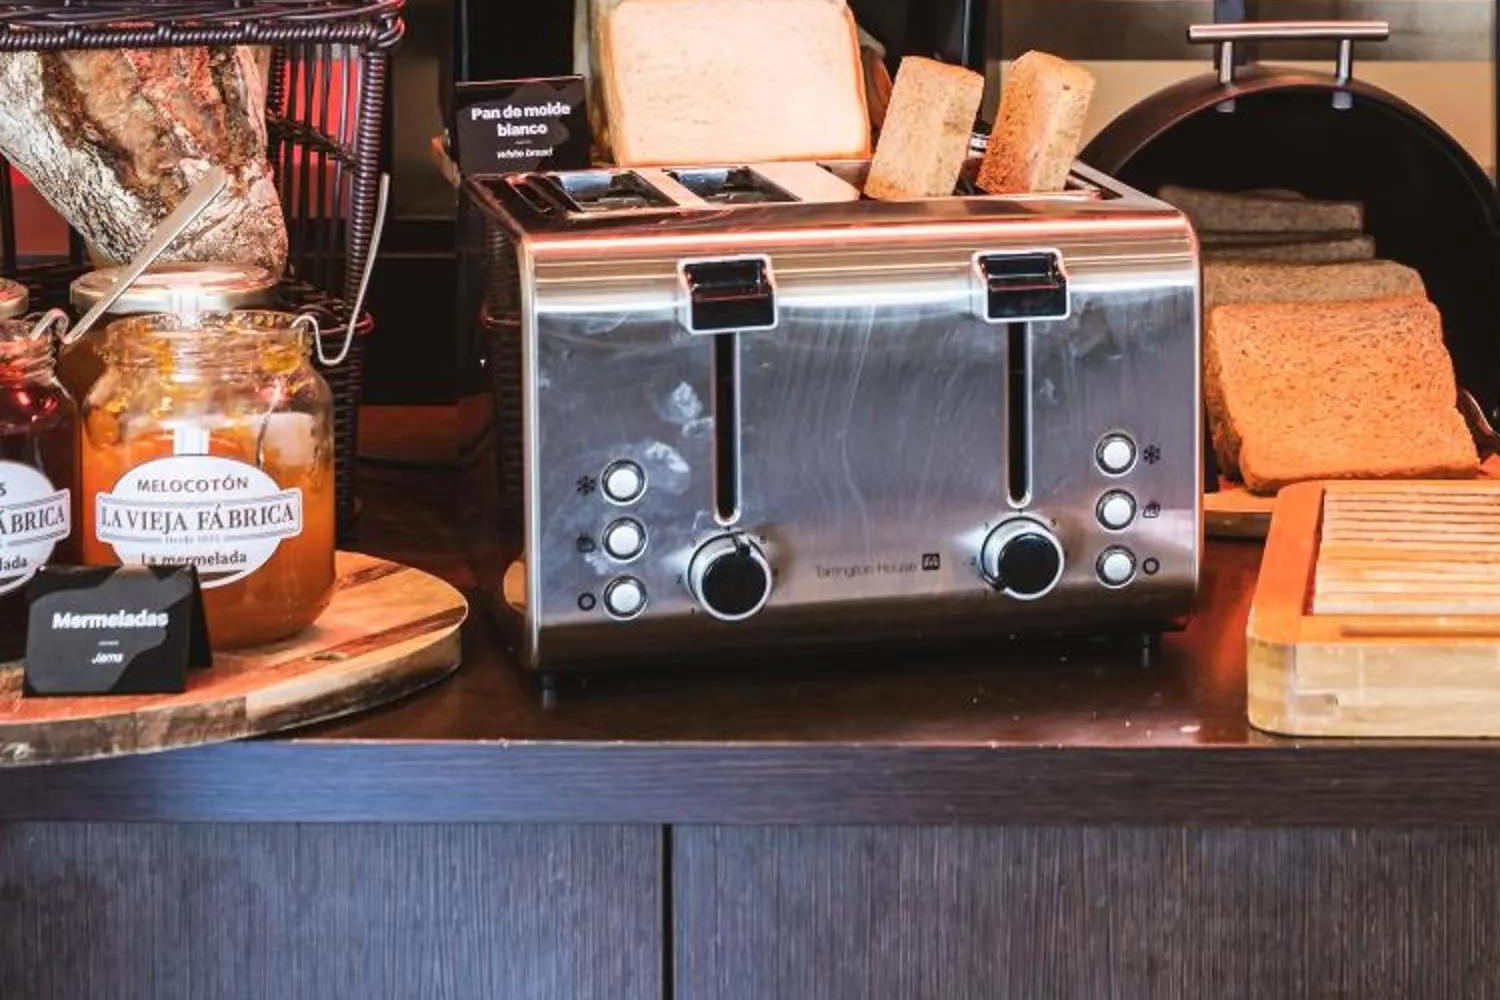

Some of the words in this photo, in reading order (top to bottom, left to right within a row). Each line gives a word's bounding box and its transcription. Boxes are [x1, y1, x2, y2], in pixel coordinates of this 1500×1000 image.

[470, 107, 501, 121] Pan
[502, 104, 522, 119] de
[524, 101, 572, 118] molde
[496, 122, 549, 137] blanco
[136, 473, 250, 494] MELOCOTÓN
[101, 506, 122, 529] LA
[123, 510, 188, 535] VIEJA
[196, 502, 295, 532] FÁBRICA
[52, 608, 170, 630] Mermeladas
